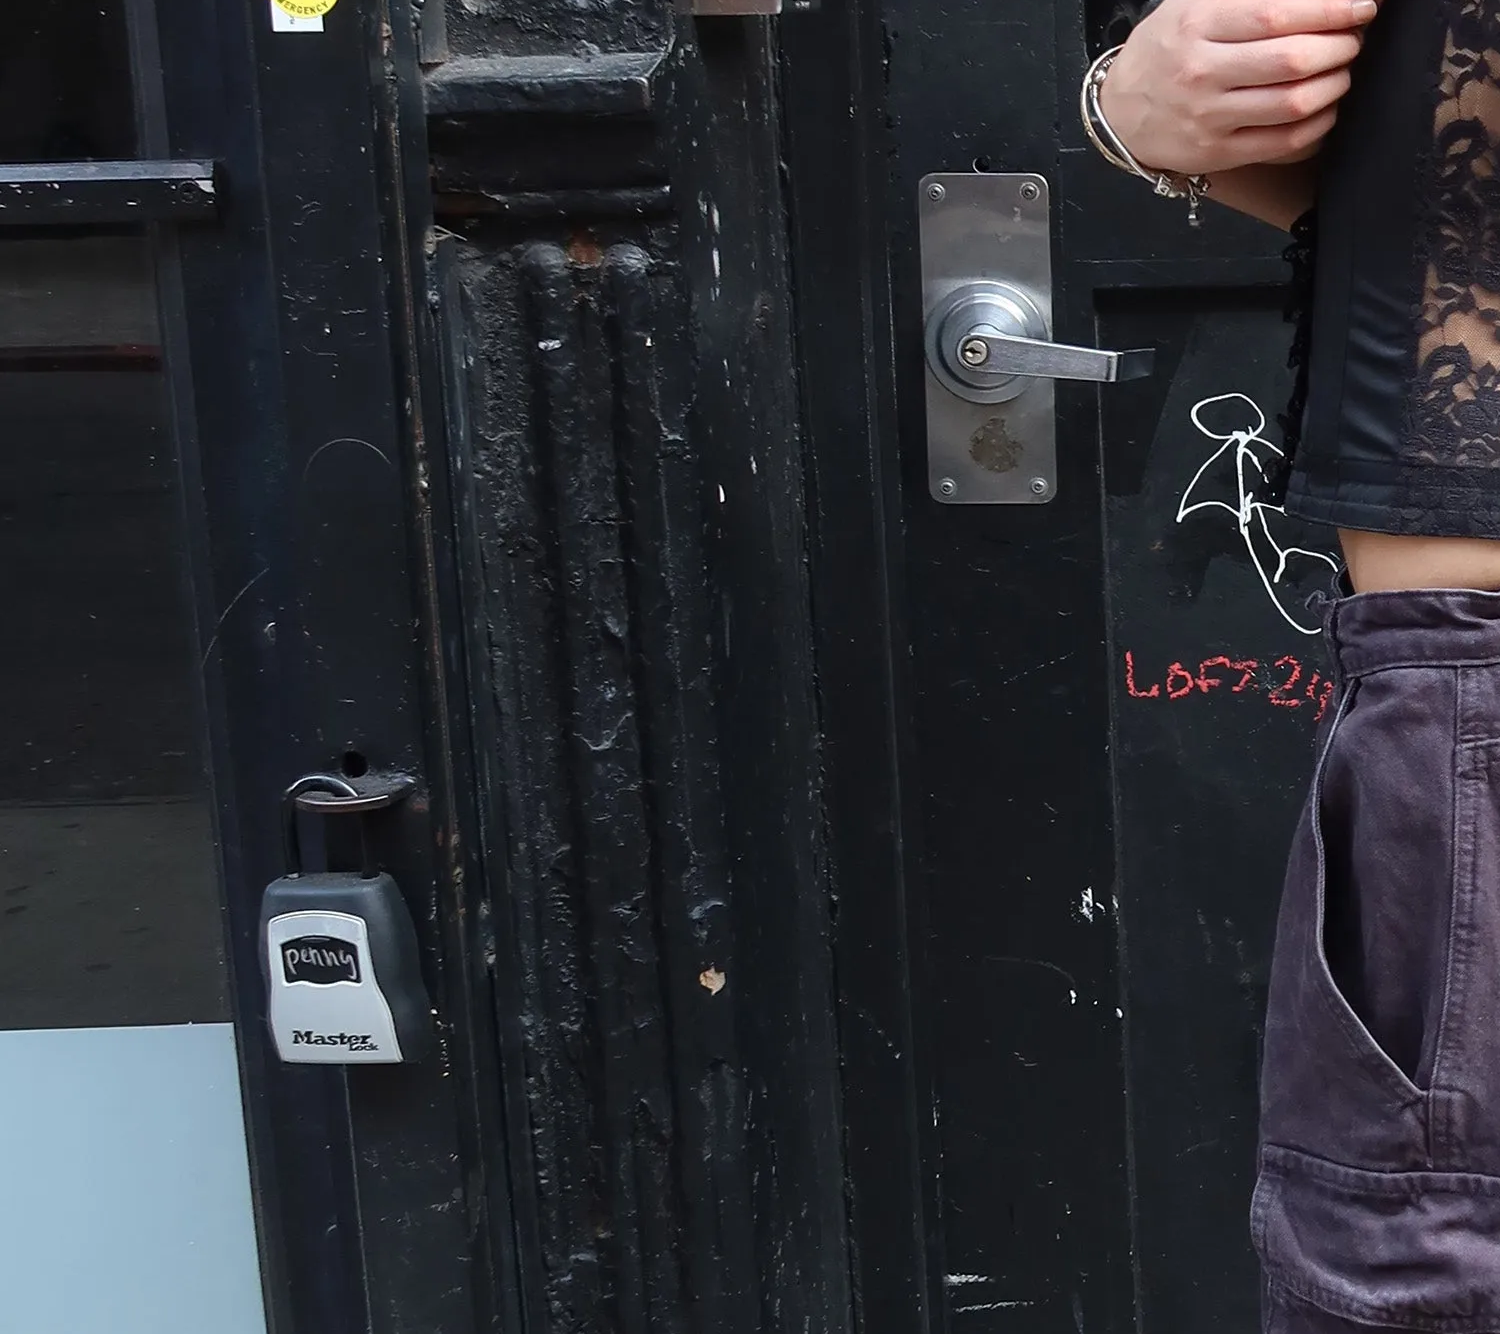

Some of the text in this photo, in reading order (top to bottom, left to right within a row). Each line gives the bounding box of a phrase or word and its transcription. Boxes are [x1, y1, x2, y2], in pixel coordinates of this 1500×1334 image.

[285, 946, 358, 980] penny
[292, 1031, 372, 1046] Master
[348, 1042, 379, 1052] Lock
